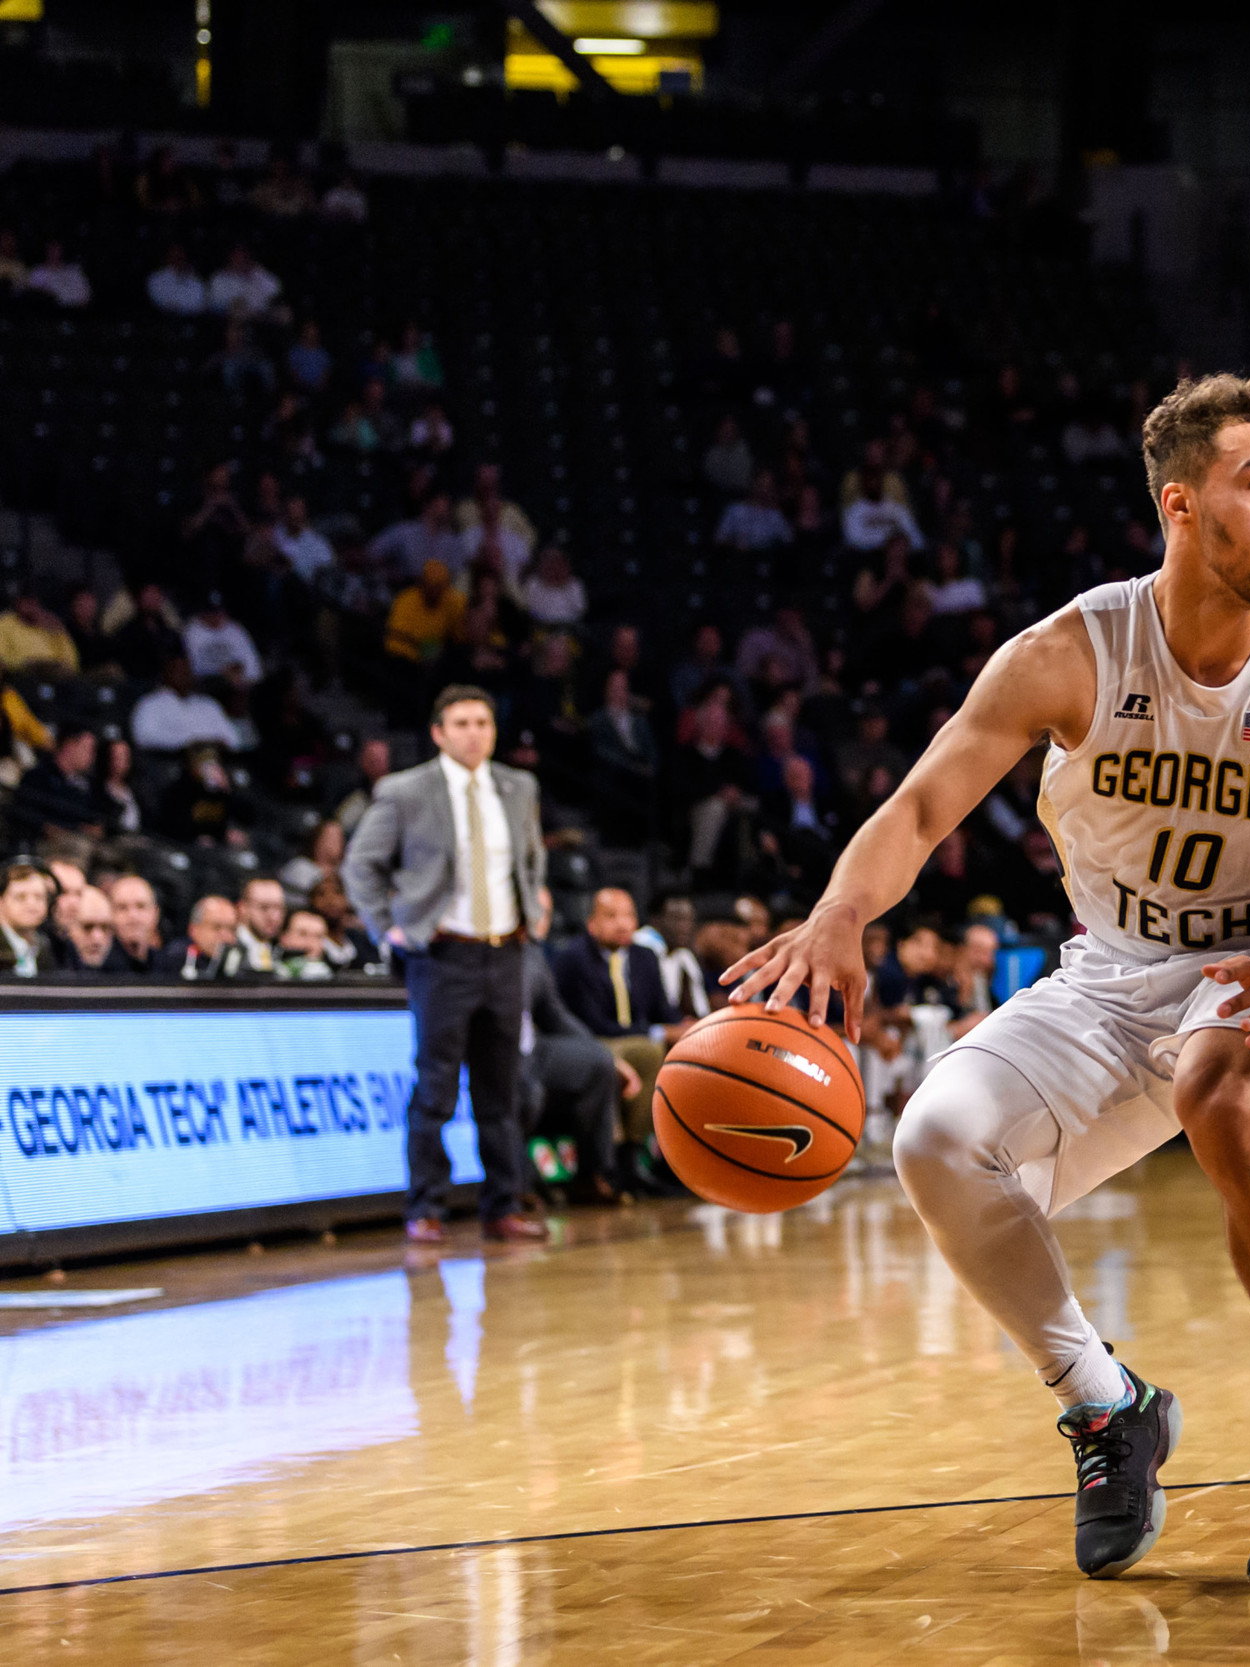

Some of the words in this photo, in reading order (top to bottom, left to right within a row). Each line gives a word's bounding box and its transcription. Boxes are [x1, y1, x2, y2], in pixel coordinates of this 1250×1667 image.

[1114, 711, 1155, 721] RUSSELL
[1148, 826, 1225, 891] 10
[9, 1082, 153, 1157] GEORGIA
[238, 1073, 368, 1138] ATHLETICS
